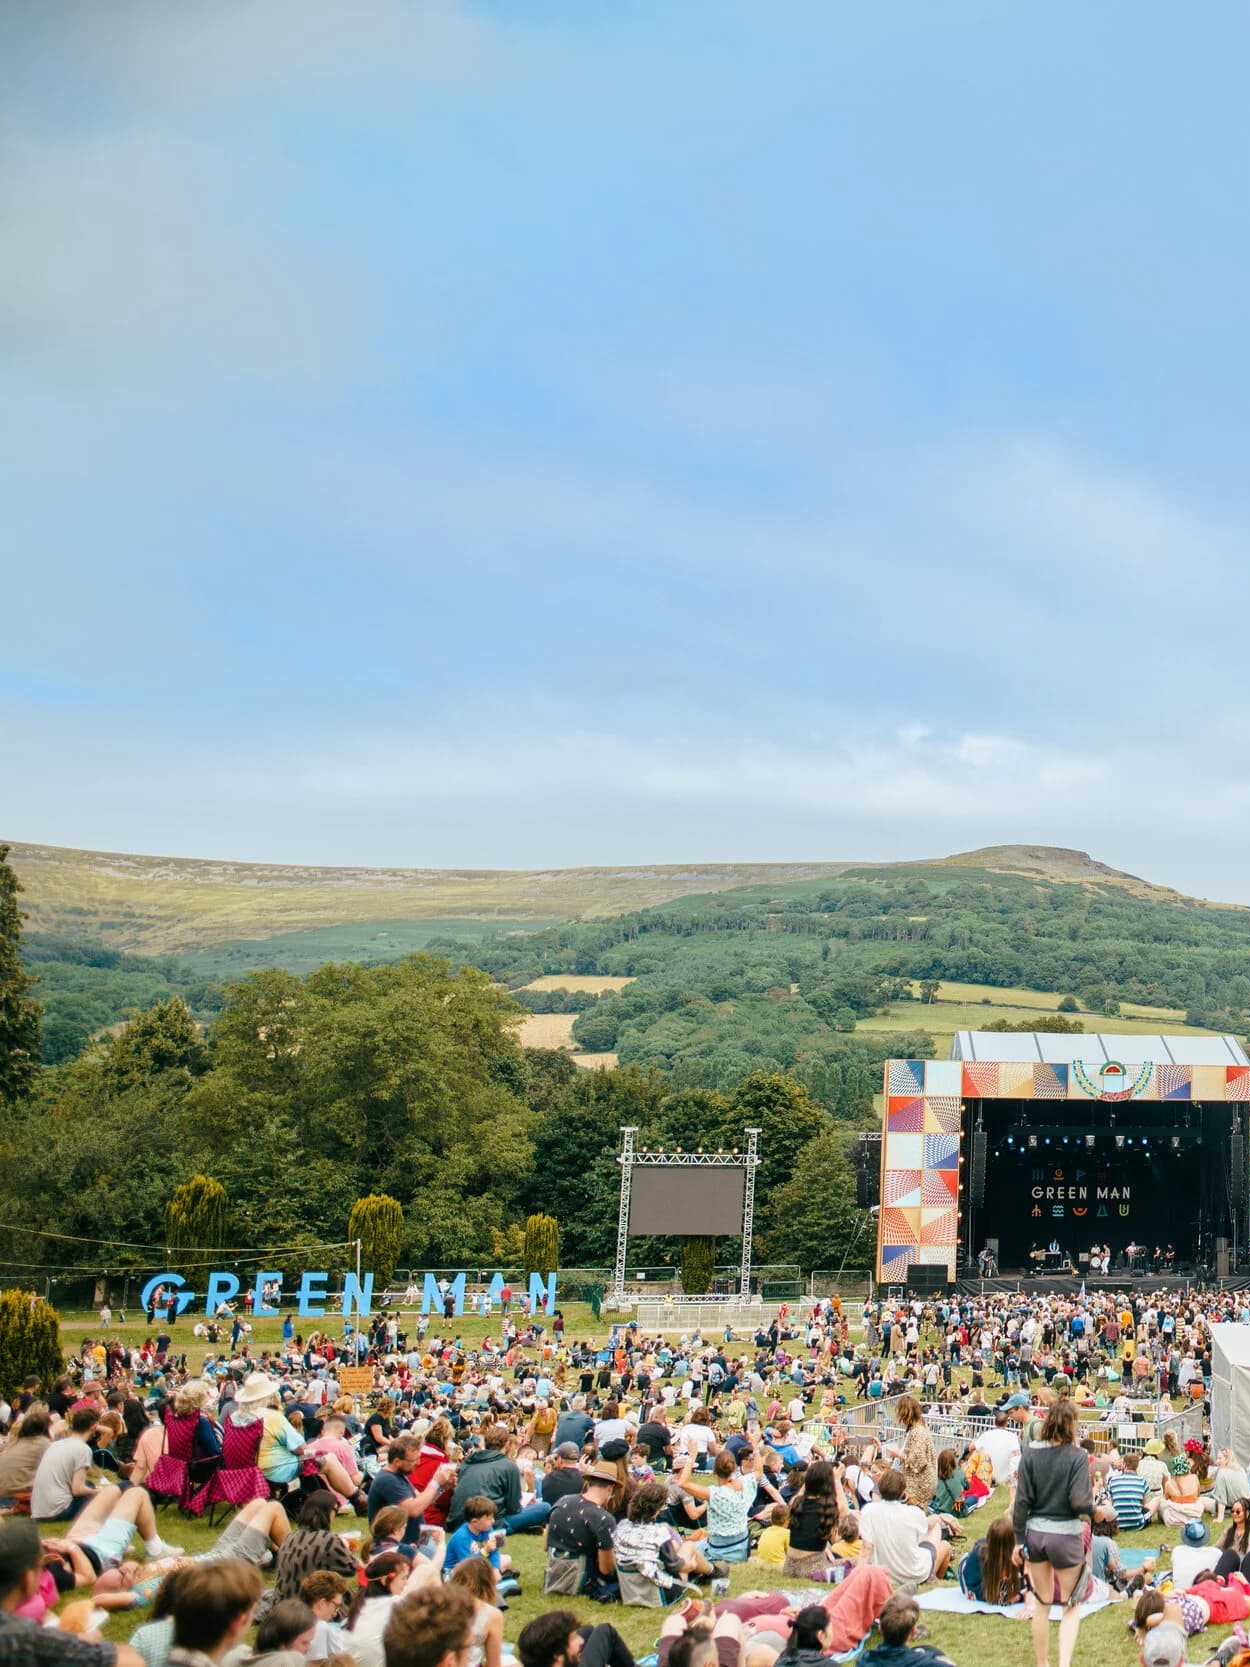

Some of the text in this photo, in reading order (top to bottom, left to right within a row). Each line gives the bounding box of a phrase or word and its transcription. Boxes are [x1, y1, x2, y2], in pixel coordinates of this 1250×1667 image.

[1032, 1186, 1131, 1199] GREEN MAN
[141, 1272, 557, 1319] GREEN MAN
